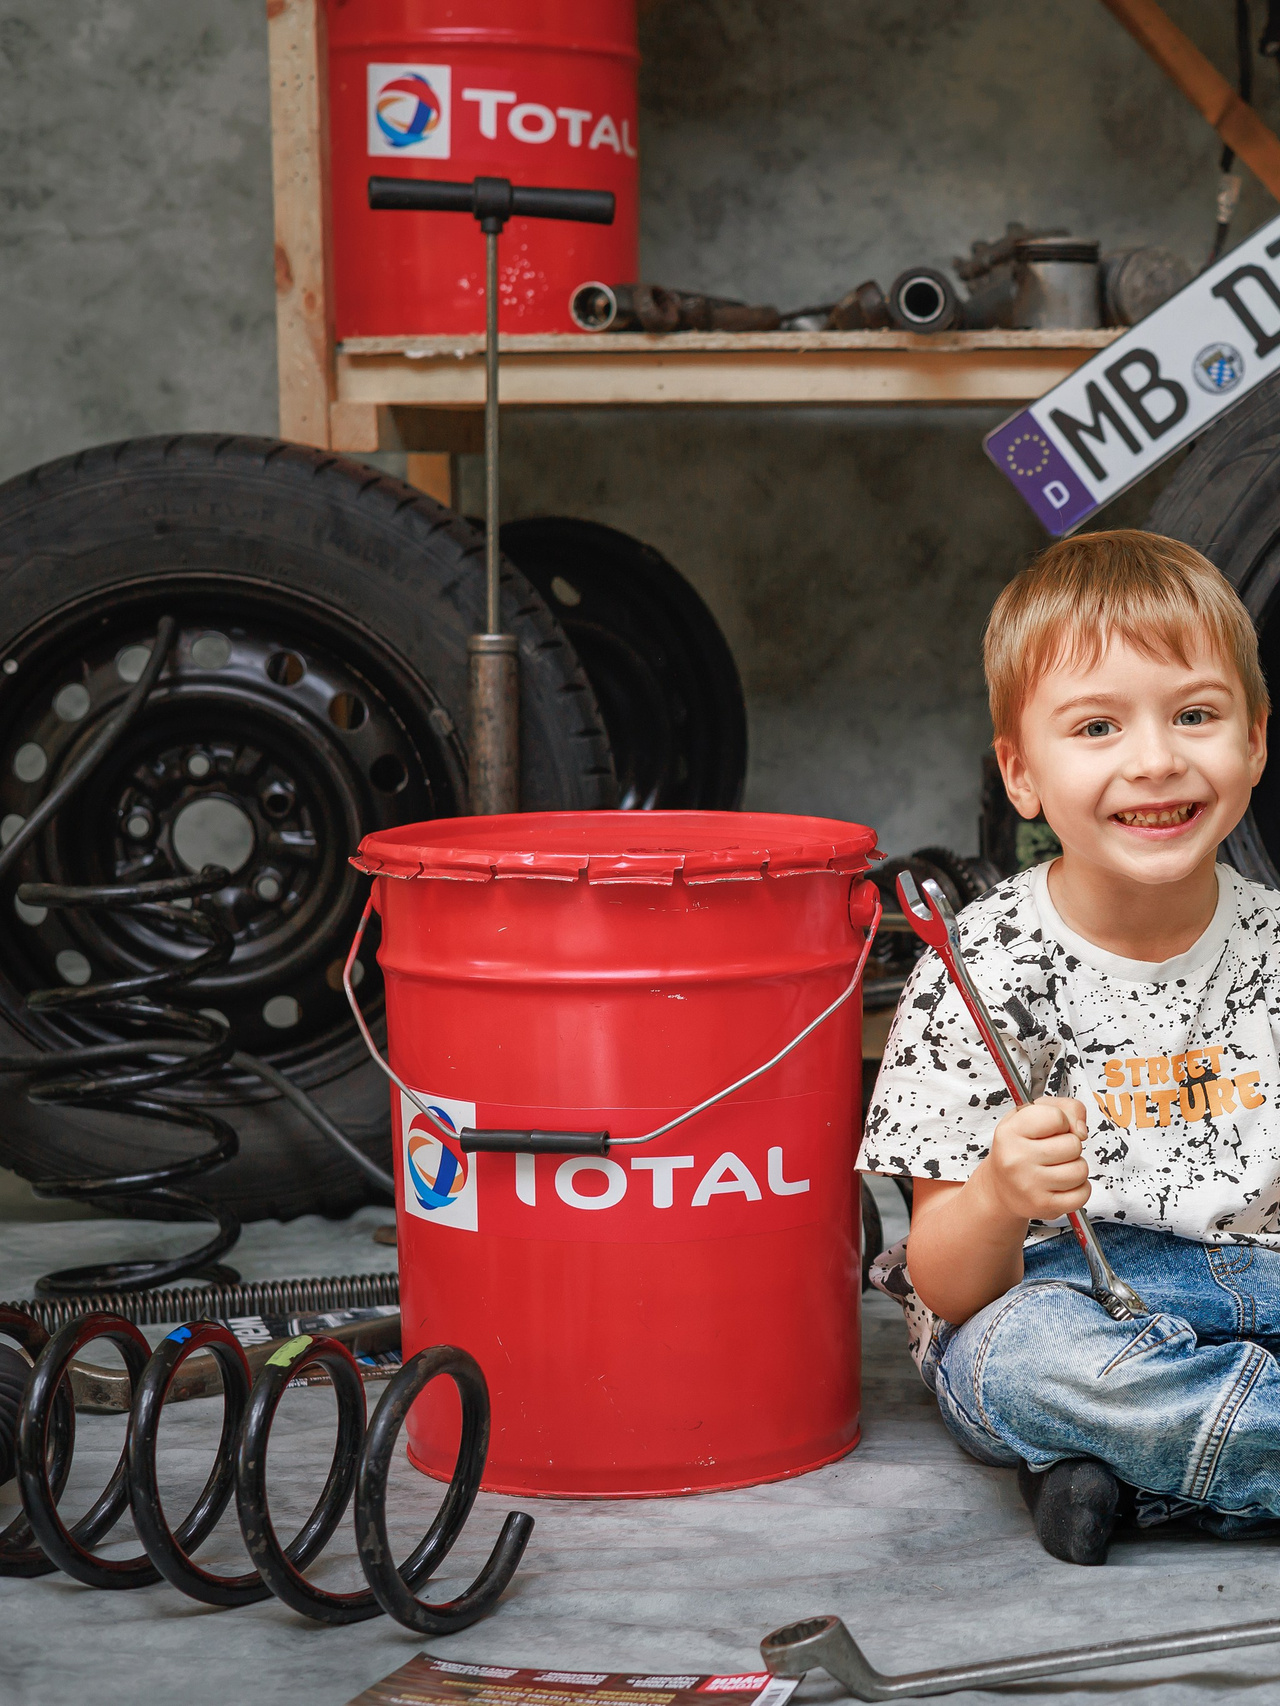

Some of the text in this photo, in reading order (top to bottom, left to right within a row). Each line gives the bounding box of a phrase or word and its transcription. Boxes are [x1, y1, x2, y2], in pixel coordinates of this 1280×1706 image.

[461, 87, 637, 158] TOTAL
[1048, 348, 1189, 482] MB
[1042, 479, 1071, 510] D
[1103, 1045, 1225, 1088] STREET
